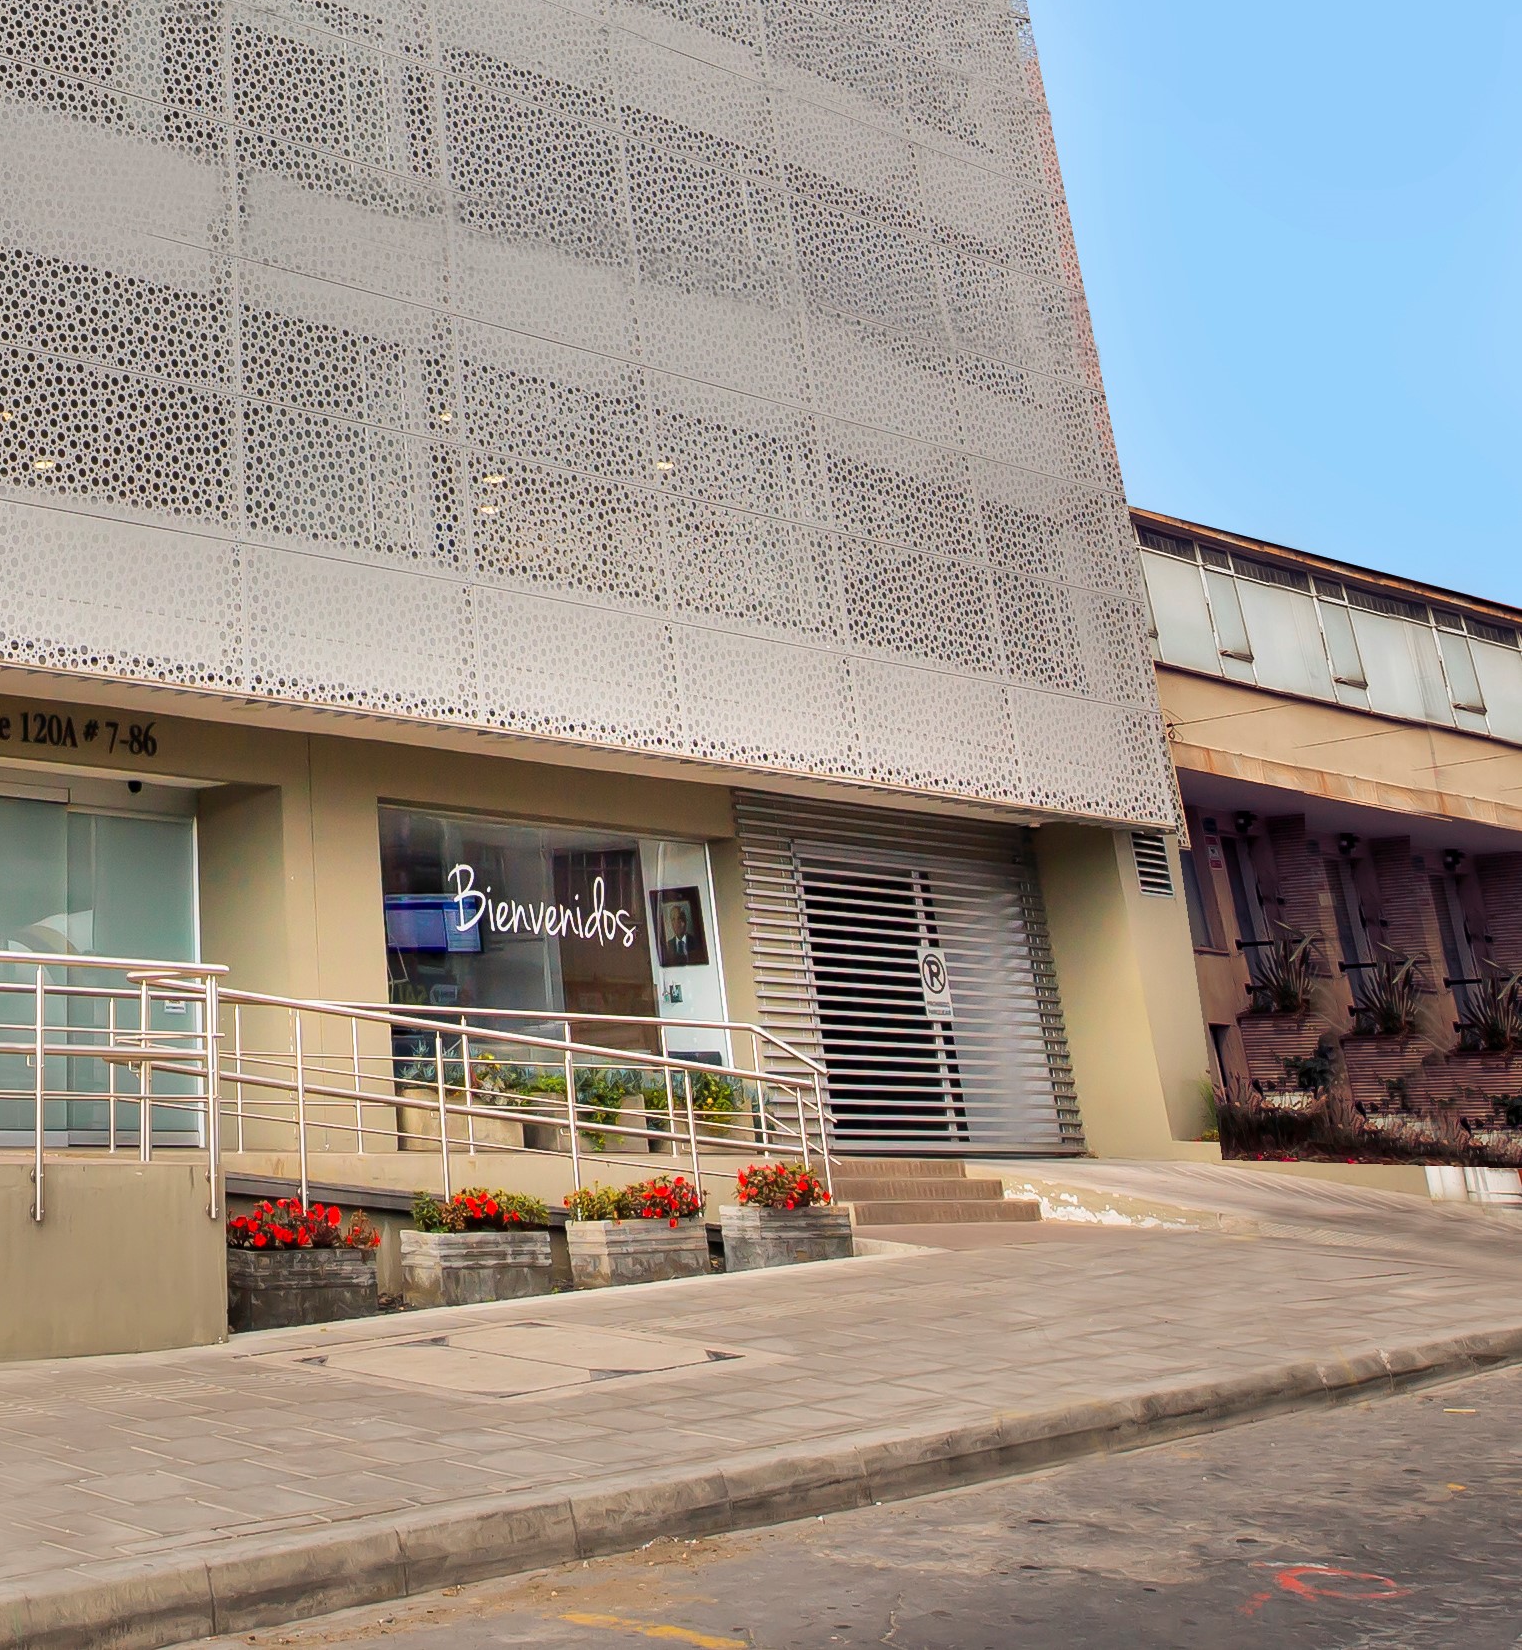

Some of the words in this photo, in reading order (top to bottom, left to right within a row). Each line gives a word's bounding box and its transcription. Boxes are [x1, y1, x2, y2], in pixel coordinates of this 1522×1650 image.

[19, 710, 79, 749] 120A
[82, 718, 100, 743] #
[104, 720, 159, 757] 7-86
[447, 862, 638, 948] Bienvenidos
